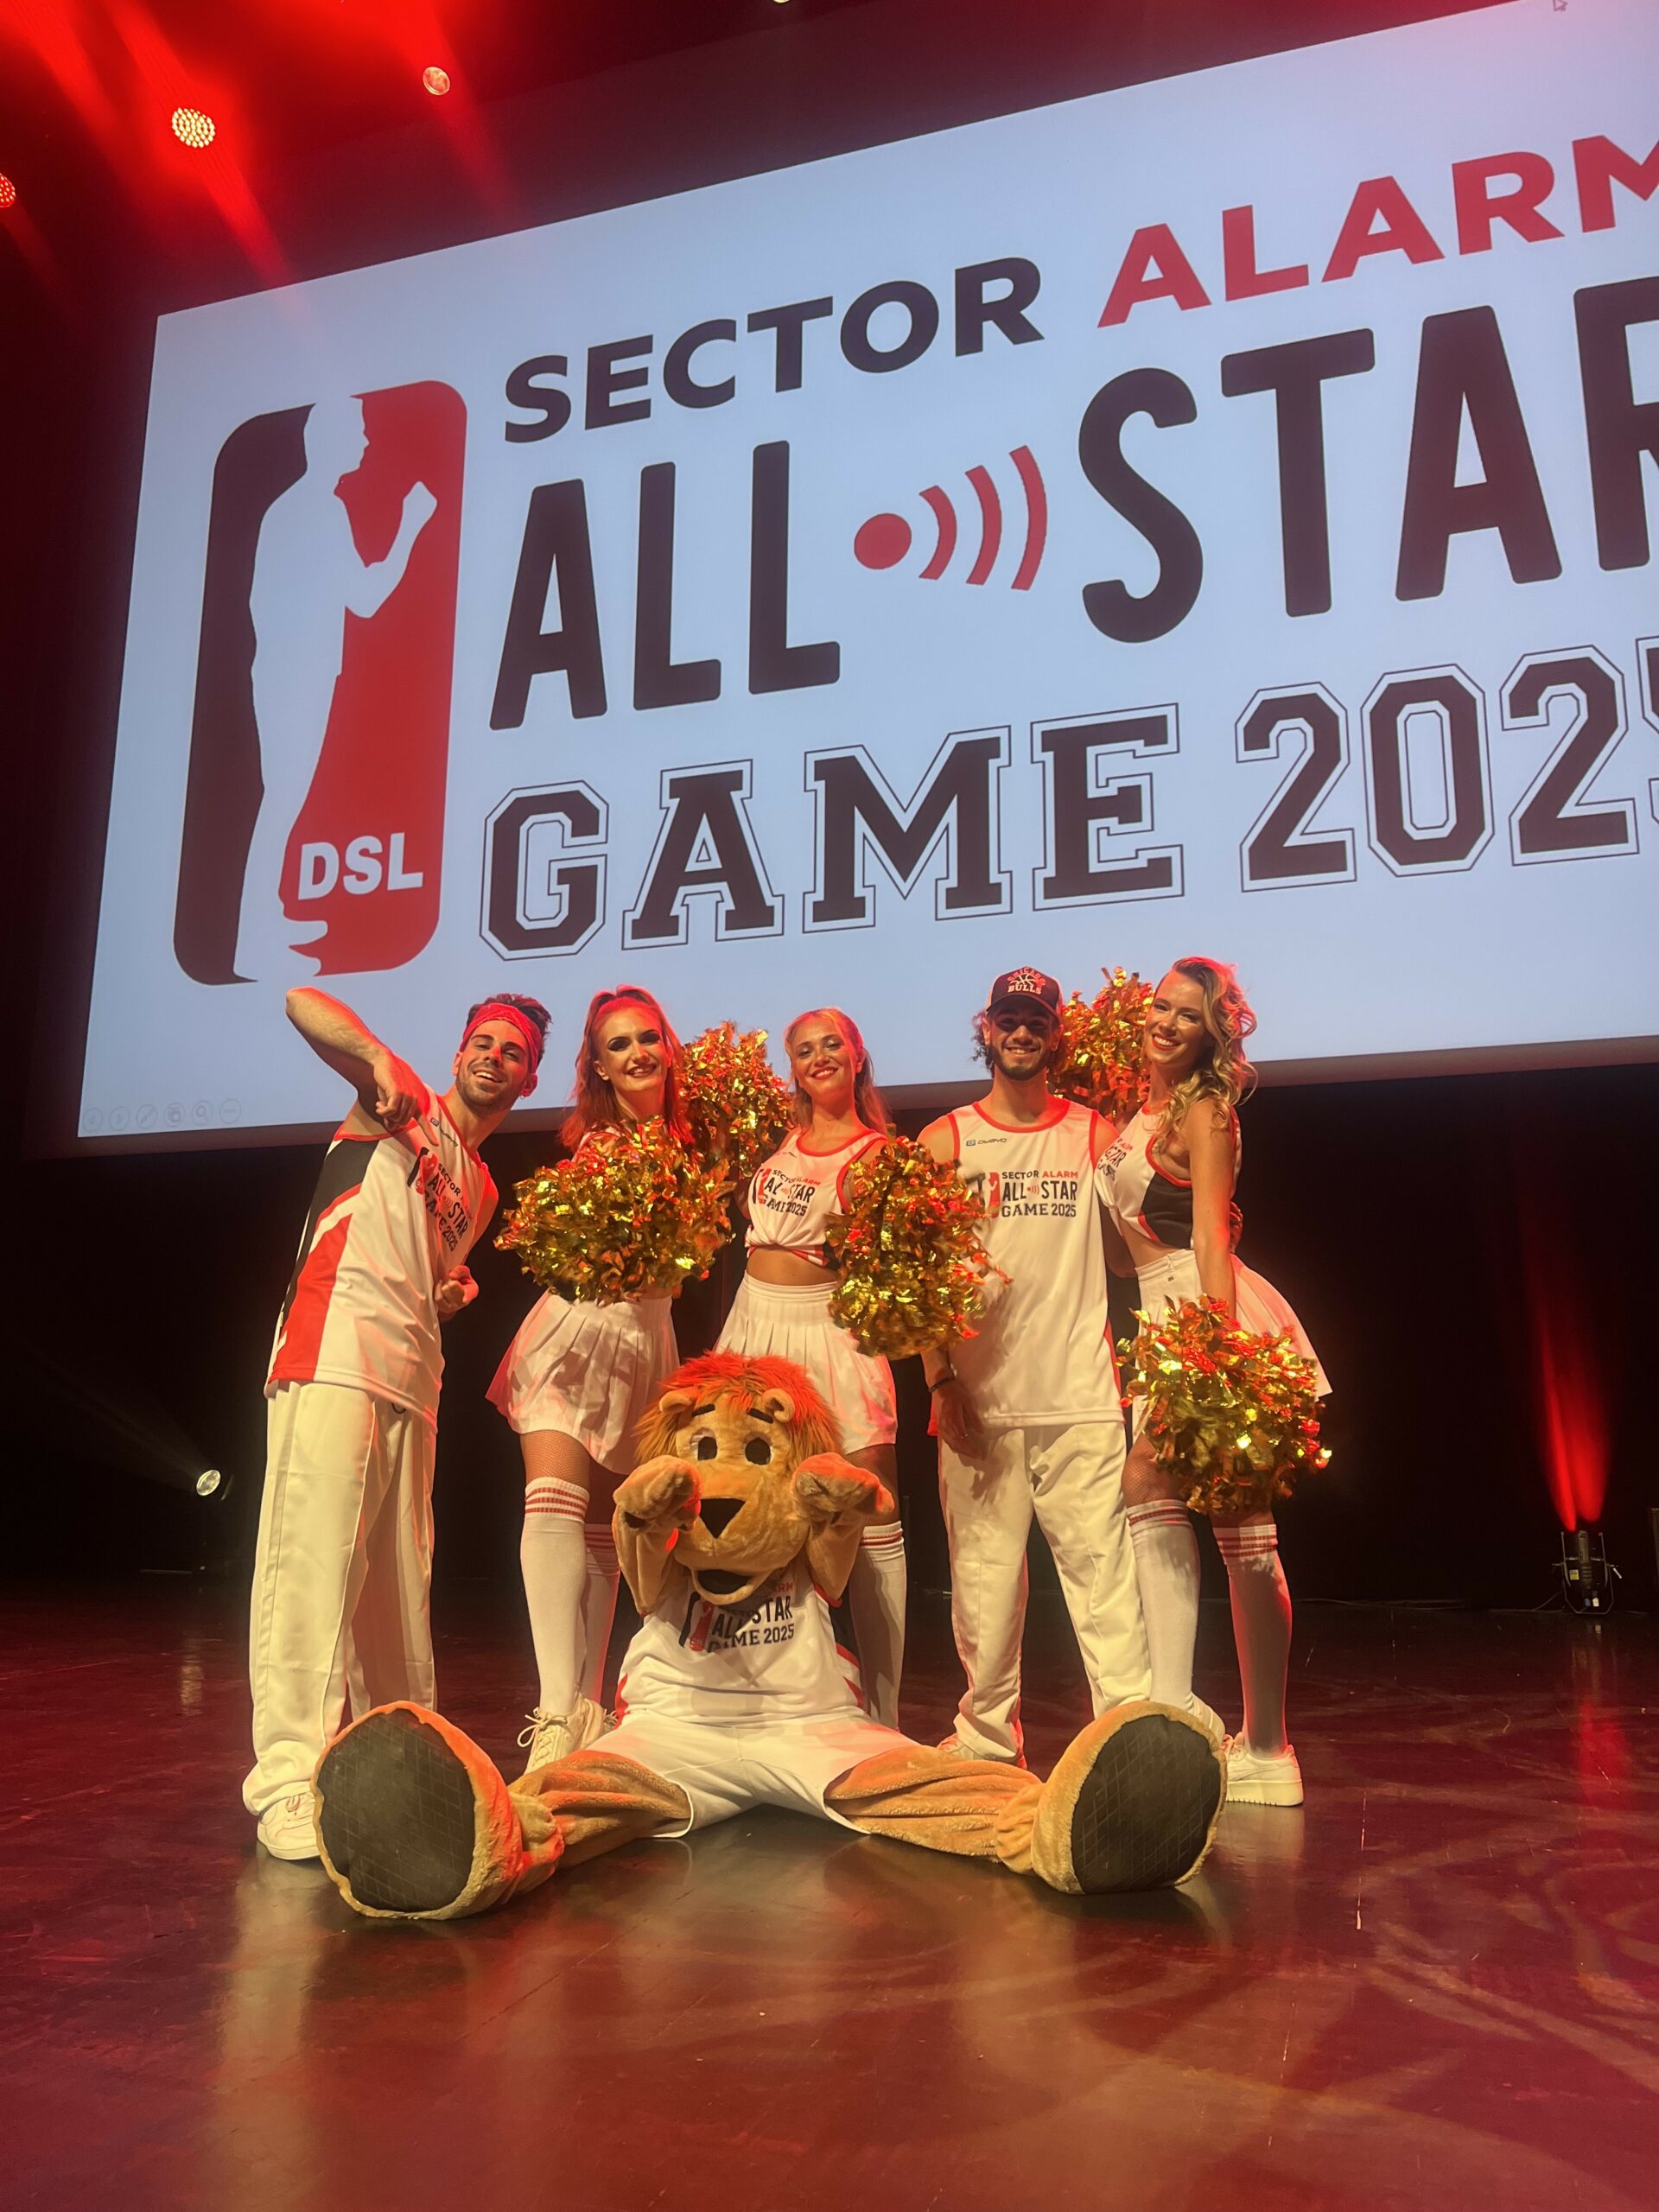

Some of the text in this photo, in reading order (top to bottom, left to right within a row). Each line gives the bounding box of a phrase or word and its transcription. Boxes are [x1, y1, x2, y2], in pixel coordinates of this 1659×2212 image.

[505, 135, 1659, 443] SECTOR ALARM
[489, 275, 1659, 730] ALL STAR
[480, 635, 1659, 962] GAME 202
[297, 831, 425, 902] DSL
[1007, 983, 1042, 995] BULLS
[437, 1163, 461, 1197] SECTOR
[1001, 1170, 1078, 1179] SECTOR ALARM
[1001, 1180, 1077, 1202] ALL STAR
[448, 1202, 468, 1240] STAR
[785, 1201, 808, 1217] 2025
[1001, 1203, 1077, 1217] GAME 2025
[442, 1226, 458, 1252] 2025
[752, 1595, 793, 1624] STAR
[762, 1624, 795, 1644] 2025
